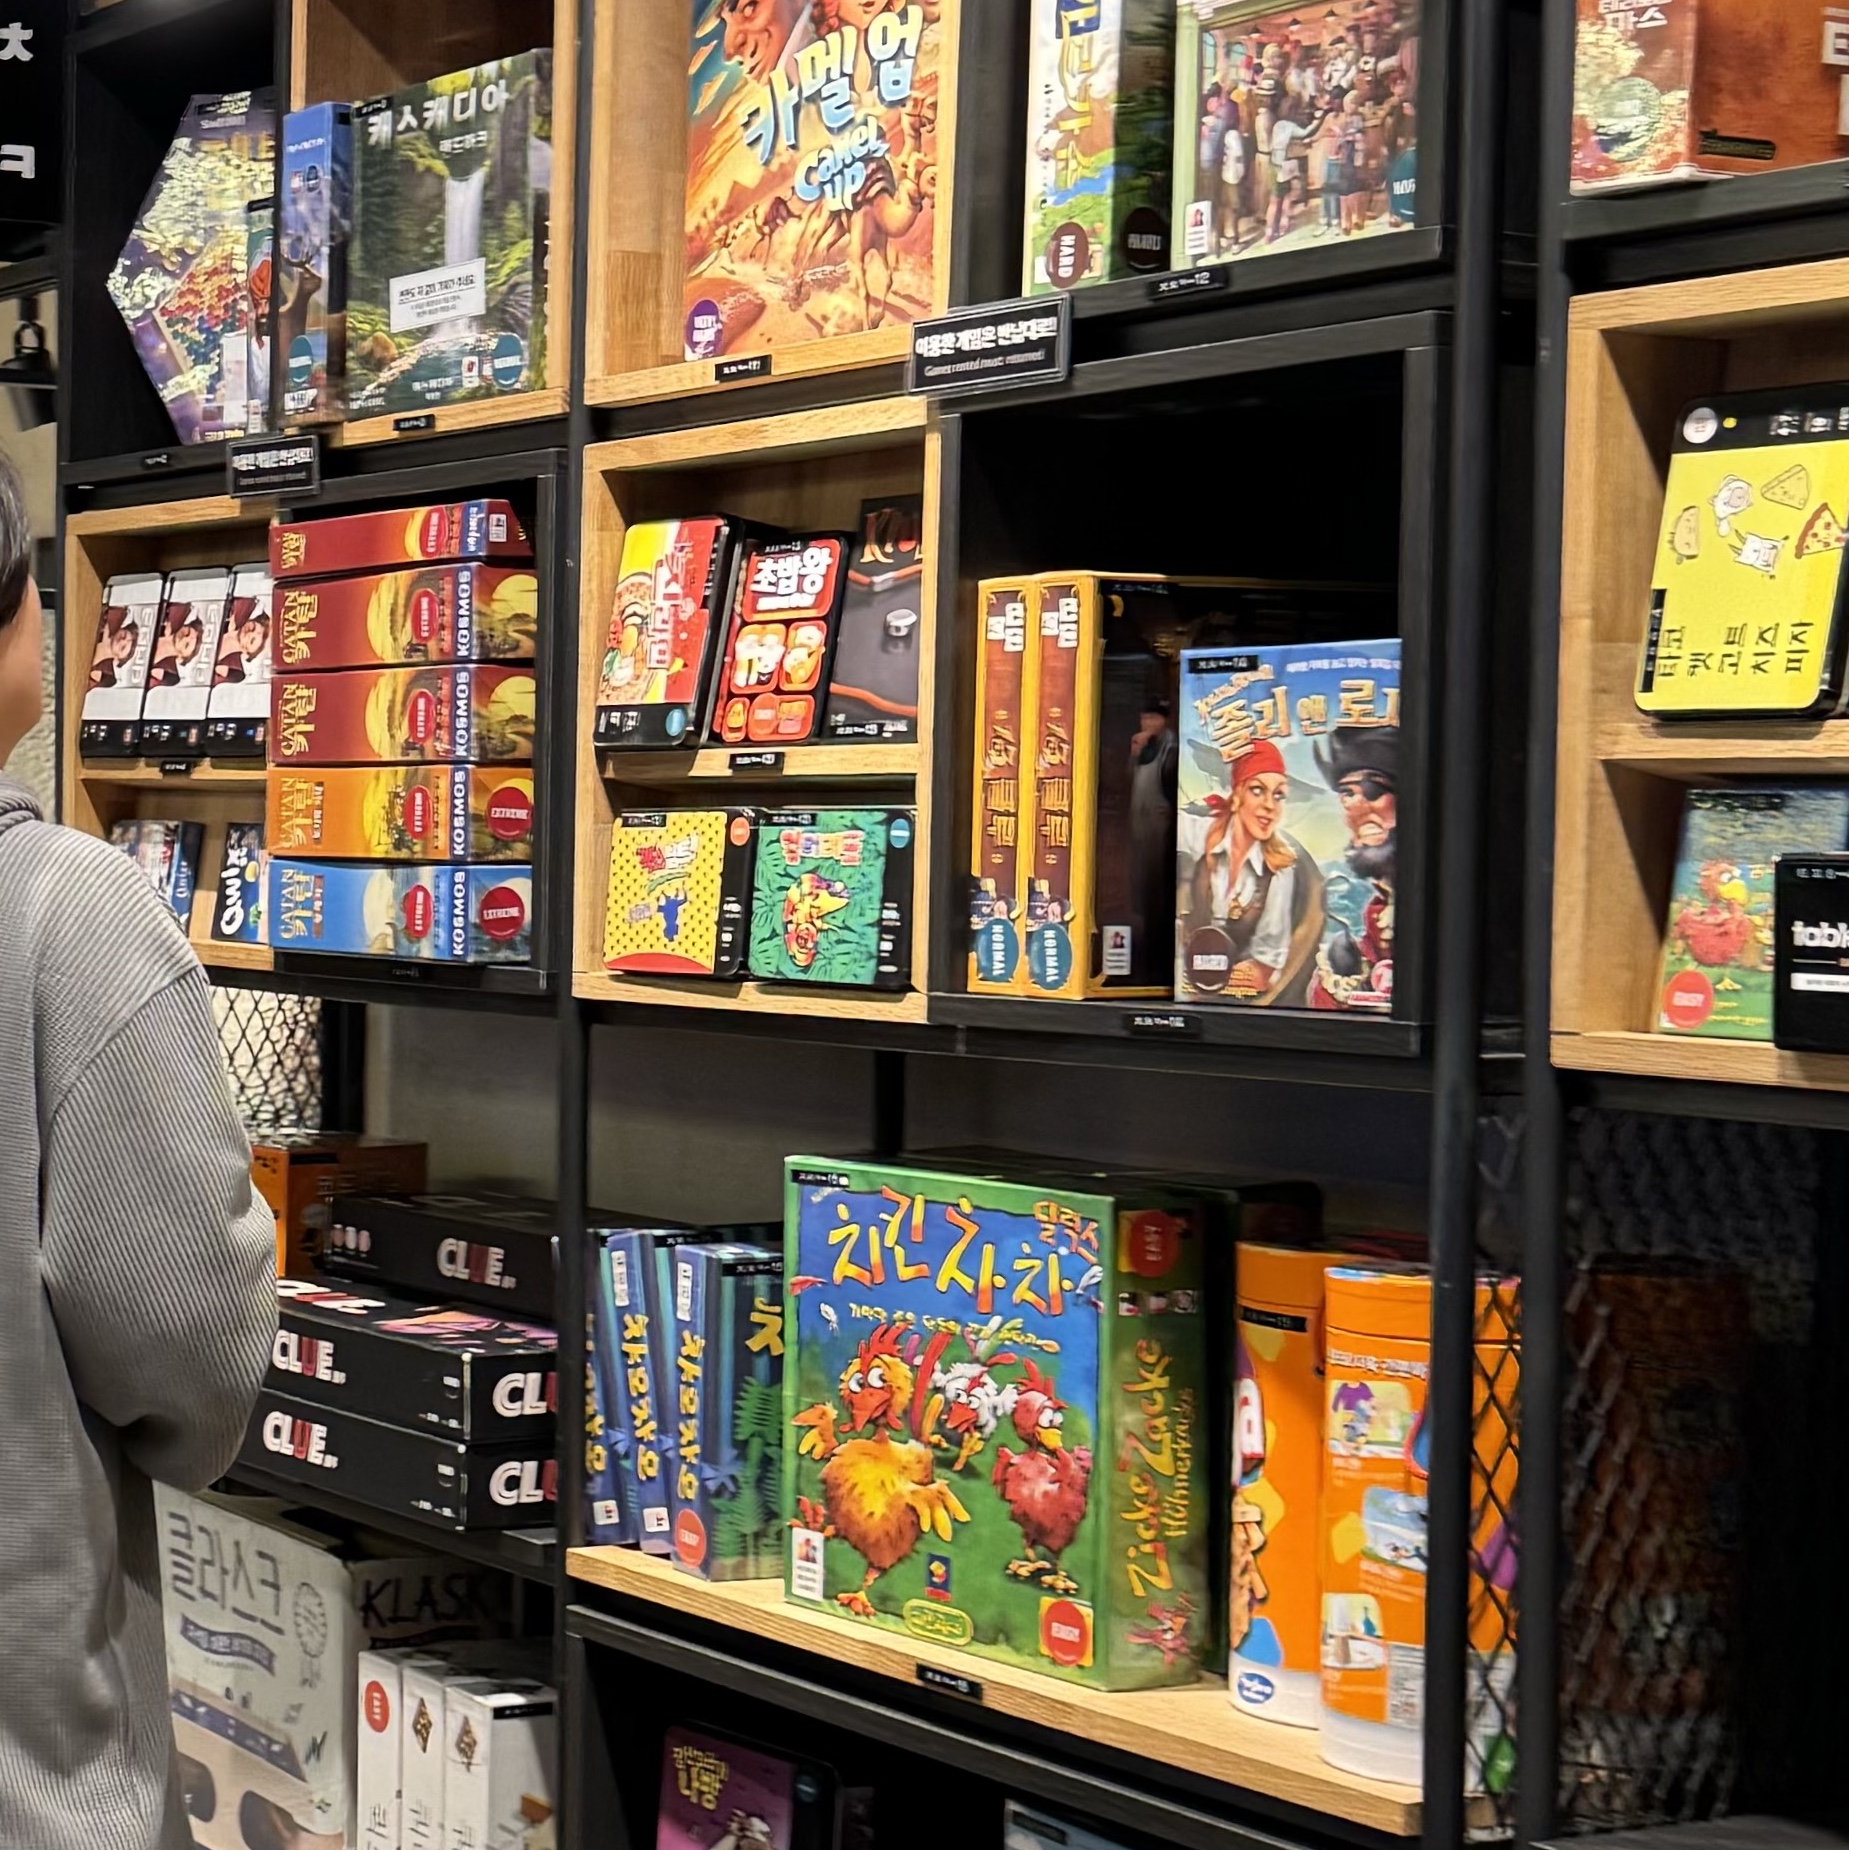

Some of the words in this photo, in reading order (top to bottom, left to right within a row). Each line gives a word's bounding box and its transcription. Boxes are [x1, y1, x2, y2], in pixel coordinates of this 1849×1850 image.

[740, 4, 925, 165] 카멜업
[367, 79, 510, 150] 캐스캐디아
[0, 143, 36, 179] ㅋ
[1057, 233, 1077, 279] HARD
[750, 546, 833, 596] 초밥왕
[282, 590, 298, 664] CATAN
[457, 570, 471, 658] KOSMOS
[1656, 626, 1687, 678] 타코
[1718, 622, 1748, 675] 고트
[1750, 622, 1780, 675] 치즈
[1784, 621, 1815, 674] 피자
[281, 683, 297, 756] CATAN
[455, 671, 470, 758] KOSMOS
[1296, 694, 1329, 734] 앤
[453, 770, 467, 856] KOSMOS
[279, 868, 295, 939] CATAN
[453, 871, 467, 956] KOSMOS
[992, 925, 1005, 974] NORMAL
[1044, 929, 1060, 984] NORMAL
[437, 1237, 506, 1286] CLUE
[272, 1329, 335, 1382] CLUE
[263, 1411, 328, 1466] CLUE
[1124, 1474, 1173, 1599] Zicke
[167, 1510, 285, 1636] 클라스크
